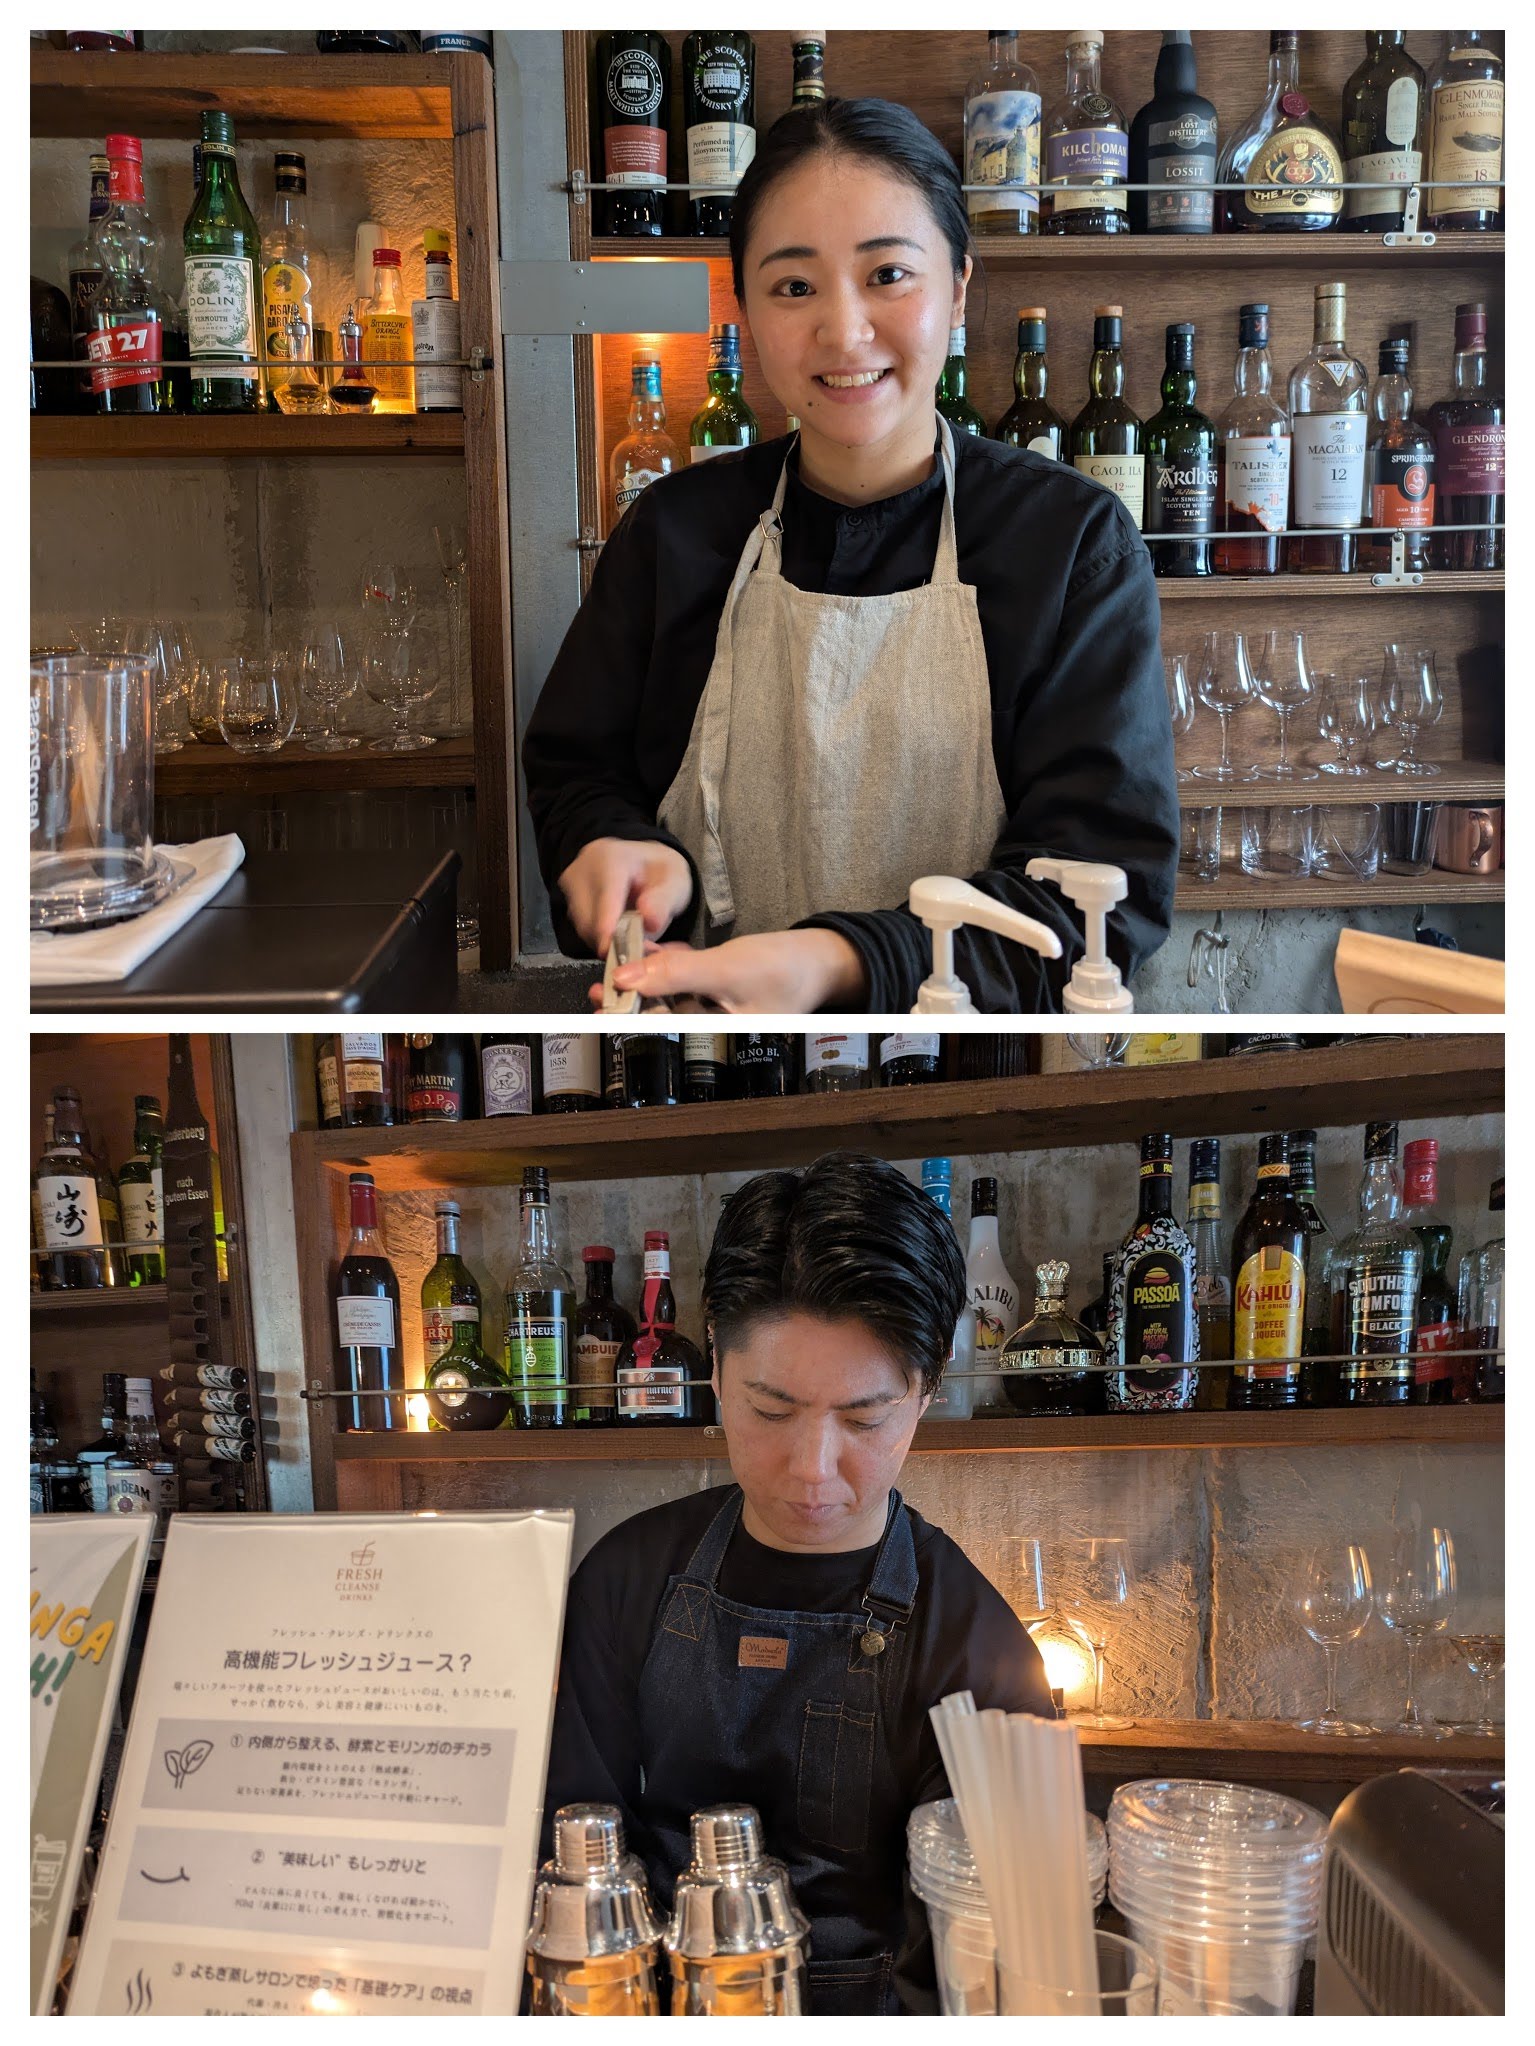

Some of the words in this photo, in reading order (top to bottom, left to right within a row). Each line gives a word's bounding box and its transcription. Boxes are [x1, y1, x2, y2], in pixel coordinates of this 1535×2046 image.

[440, 38, 471, 47] FRANCE
[624, 52, 656, 70] SCOTCH
[697, 49, 713, 66] THE
[714, 46, 746, 67] SCOTCH
[608, 81, 618, 101] MALT
[616, 99, 645, 113] WHISKY
[645, 82, 661, 111] SOCIETY
[693, 73, 703, 96] MALT
[701, 94, 732, 111] WHISKY
[733, 74, 750, 107] SOCIETY
[1458, 111, 1476, 120] MALT
[1166, 167, 1205, 178] LOSSIT
[1388, 171, 1407, 181] 16
[1474, 168, 1488, 182] 18
[1253, 190, 1279, 200] THE
[189, 296, 235, 306] DOLIN
[194, 315, 229, 323] VERMOUTH
[116, 329, 148, 351] 27
[1332, 363, 1343, 373] 12
[1308, 444, 1364, 455] MACALLAN
[1090, 464, 1126, 477] CAOL
[1129, 466, 1142, 476] ILA
[1484, 462, 1497, 472] 12
[1330, 468, 1348, 481] 12
[1113, 482, 1125, 491] 12
[1409, 506, 1420, 514] 10
[1247, 1035, 1270, 1045] CACAO
[737, 1050, 746, 1060] KI
[748, 1048, 763, 1058] NO
[416, 1074, 453, 1087] MARTIN
[176, 1175, 194, 1188] nach
[1419, 1174, 1431, 1183] 27
[187, 1189, 209, 1200] Essen
[1348, 1275, 1419, 1297] SOUTHERN
[1133, 1282, 1181, 1305] PASSOÃ
[1352, 1294, 1415, 1313] COMFORT
[1254, 1320, 1285, 1330] COFFEE
[1369, 1321, 1402, 1331] BLACK
[508, 1325, 562, 1337] CHARTREUSE
[107, 1483, 120, 1500] JIM
[120, 1479, 151, 1502] BEAM
[336, 1568, 383, 1580] FRESH
[335, 1582, 381, 1591] CLEANSE
[223, 1649, 472, 1673] 高機能フレッシュジュース？
